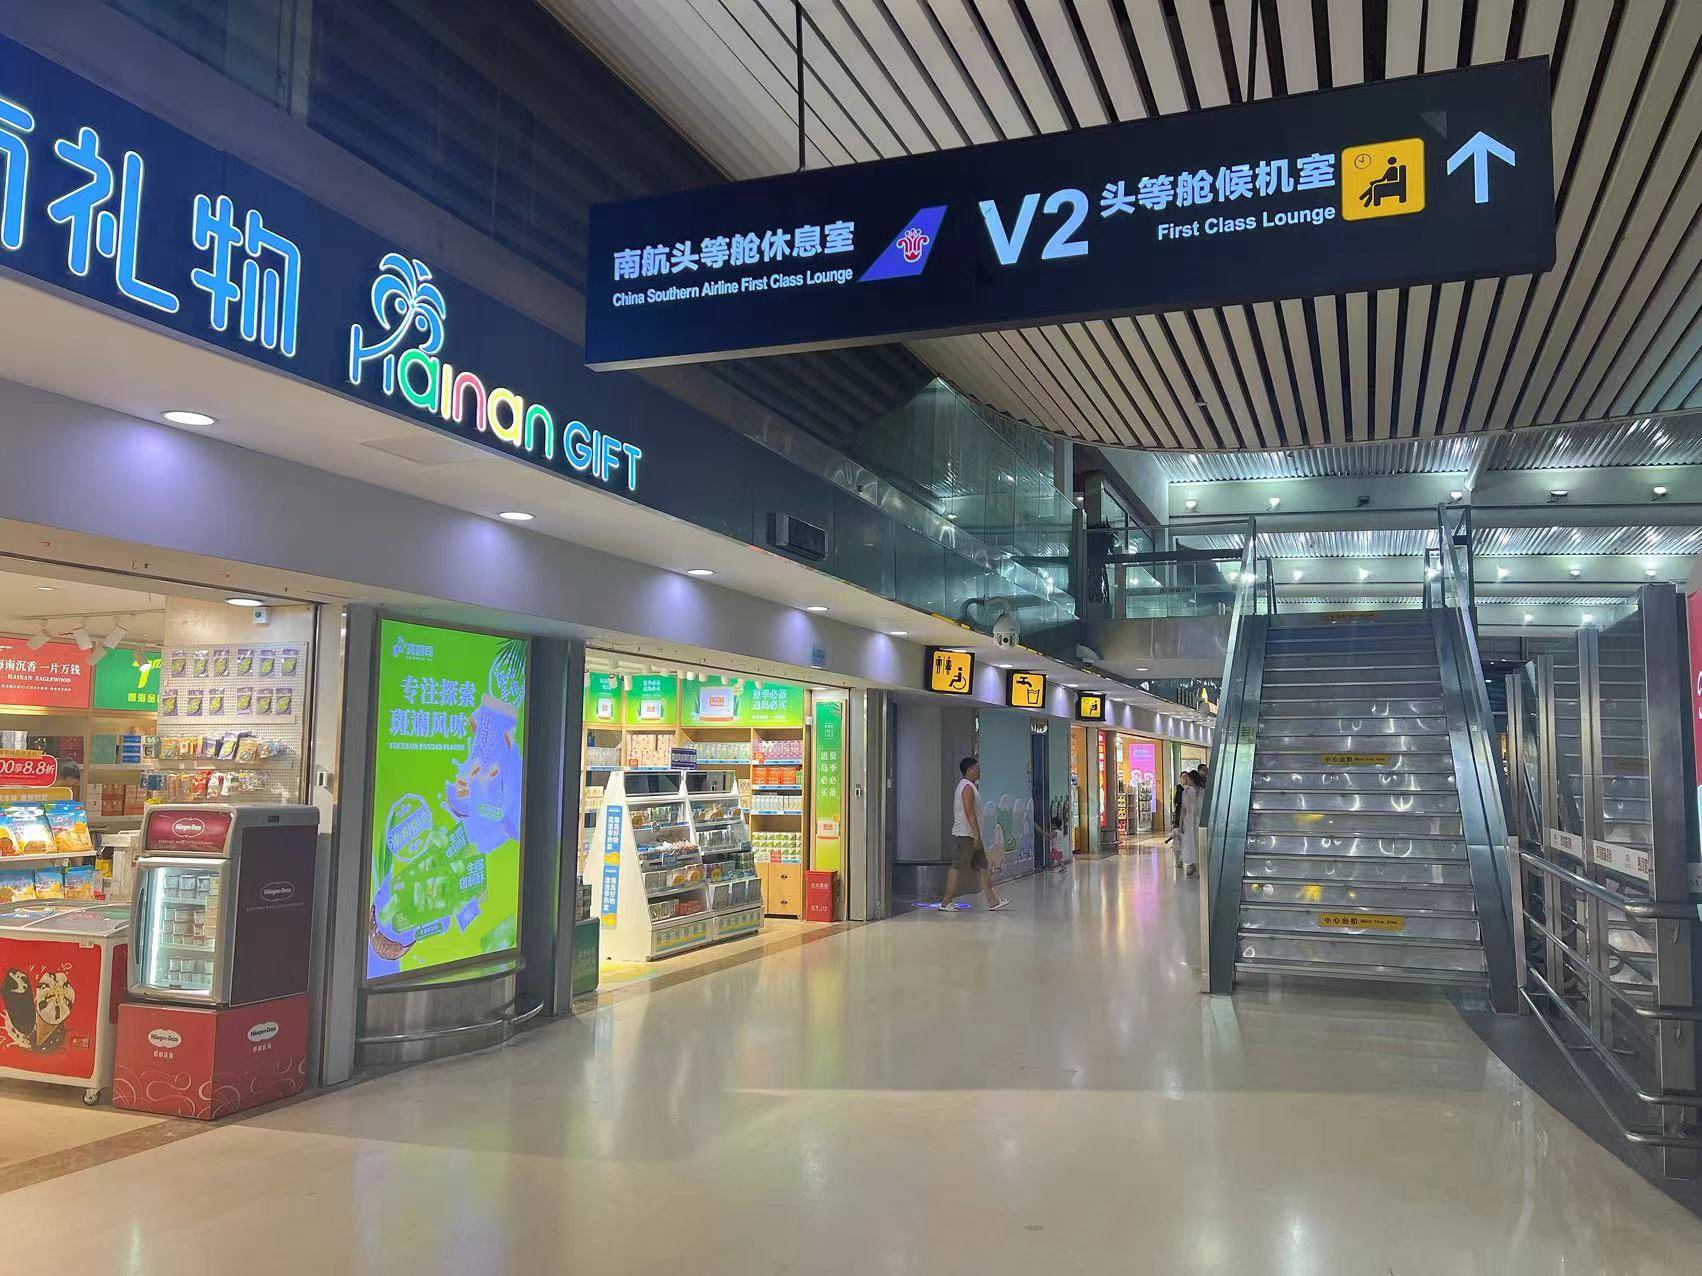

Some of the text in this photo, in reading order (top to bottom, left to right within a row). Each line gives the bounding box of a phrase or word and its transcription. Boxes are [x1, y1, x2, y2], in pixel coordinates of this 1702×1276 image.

[1100, 153, 1335, 218] 头等舱候机室
[0, 97, 302, 358] 礼物
[978, 188, 1089, 266] V2
[1157, 205, 1336, 241] First Class Lounge
[613, 220, 855, 281] 南航头等舱休息室
[612, 268, 854, 307] China Southern Airline First Class Lounge
[563, 420, 642, 491] GIFT
[35, 676, 72, 684] EAGLEWOOD
[400, 675, 476, 707] 专注探索
[753, 688, 787, 700] 夏季必备
[829, 752, 838, 797] 夏季必备
[1324, 916, 1358, 925] 小心台阶
